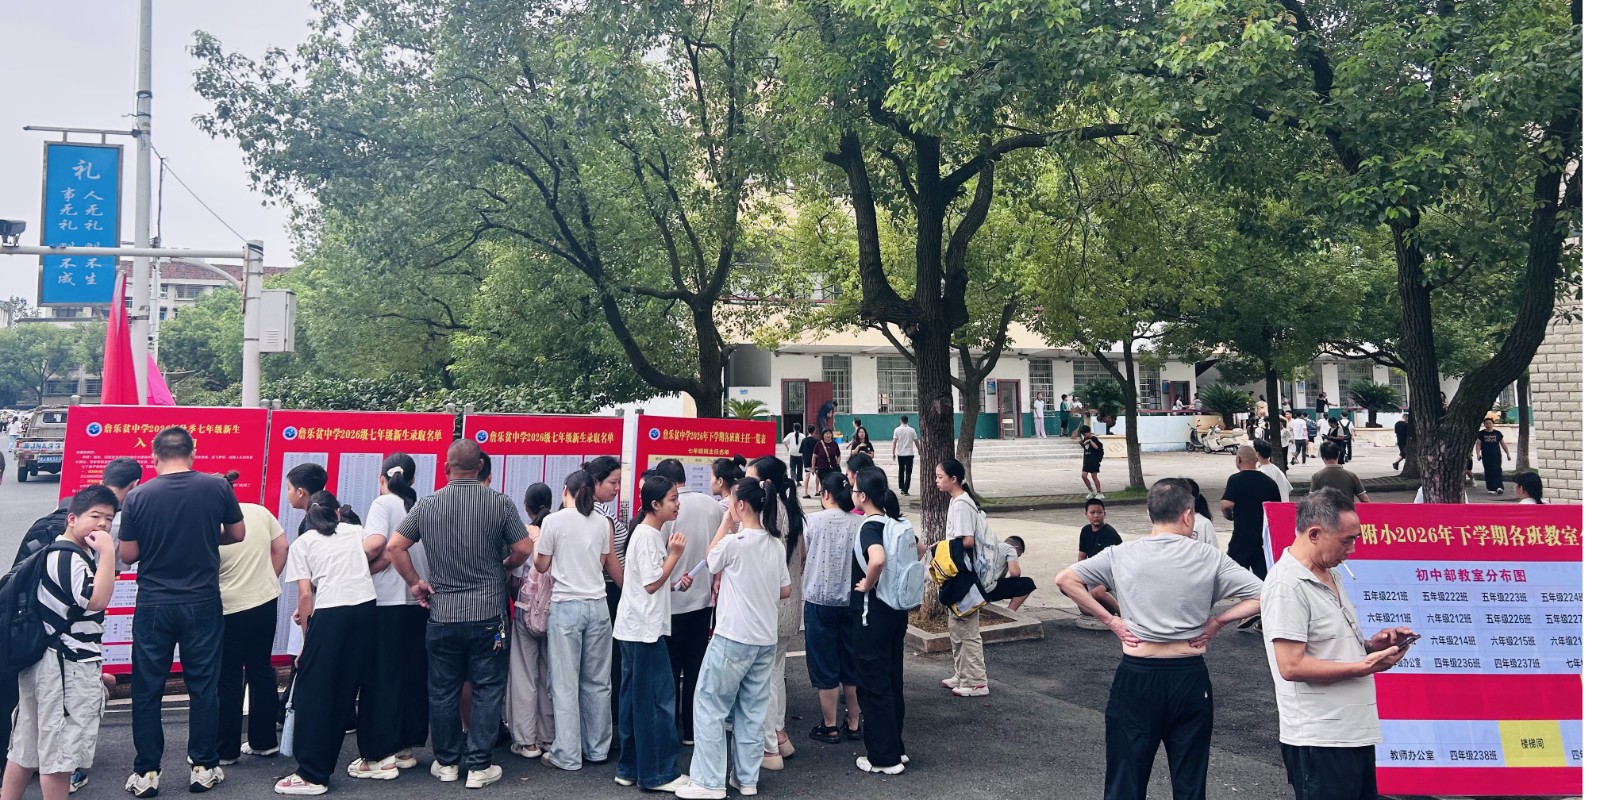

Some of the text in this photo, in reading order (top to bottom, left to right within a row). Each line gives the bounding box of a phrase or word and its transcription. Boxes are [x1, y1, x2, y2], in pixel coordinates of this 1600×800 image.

[72, 159, 101, 181] 礼
[1360, 523, 1583, 547] 附小2026年下学期各班教室
[1415, 568, 1527, 583] 初中部教室分布图
[1363, 590, 1409, 602] 五年级221班
[1422, 591, 1469, 602] 五年级222班
[1481, 592, 1528, 603] 五年级223班
[1367, 612, 1412, 623] 六年级211班
[1427, 613, 1473, 624] 六年级212班
[1486, 613, 1532, 624] 五年级226班
[1430, 635, 1477, 646] 六年级214班
[1490, 635, 1536, 647] 六年级215班
[1433, 657, 1481, 669] 四年级236班
[1494, 657, 1541, 669] 四年级237班
[1565, 658, 1583, 669] 七年
[1520, 738, 1545, 749] 楼梯间
[1390, 749, 1435, 761] 教师办公室
[1449, 750, 1498, 761] 四年级238班
